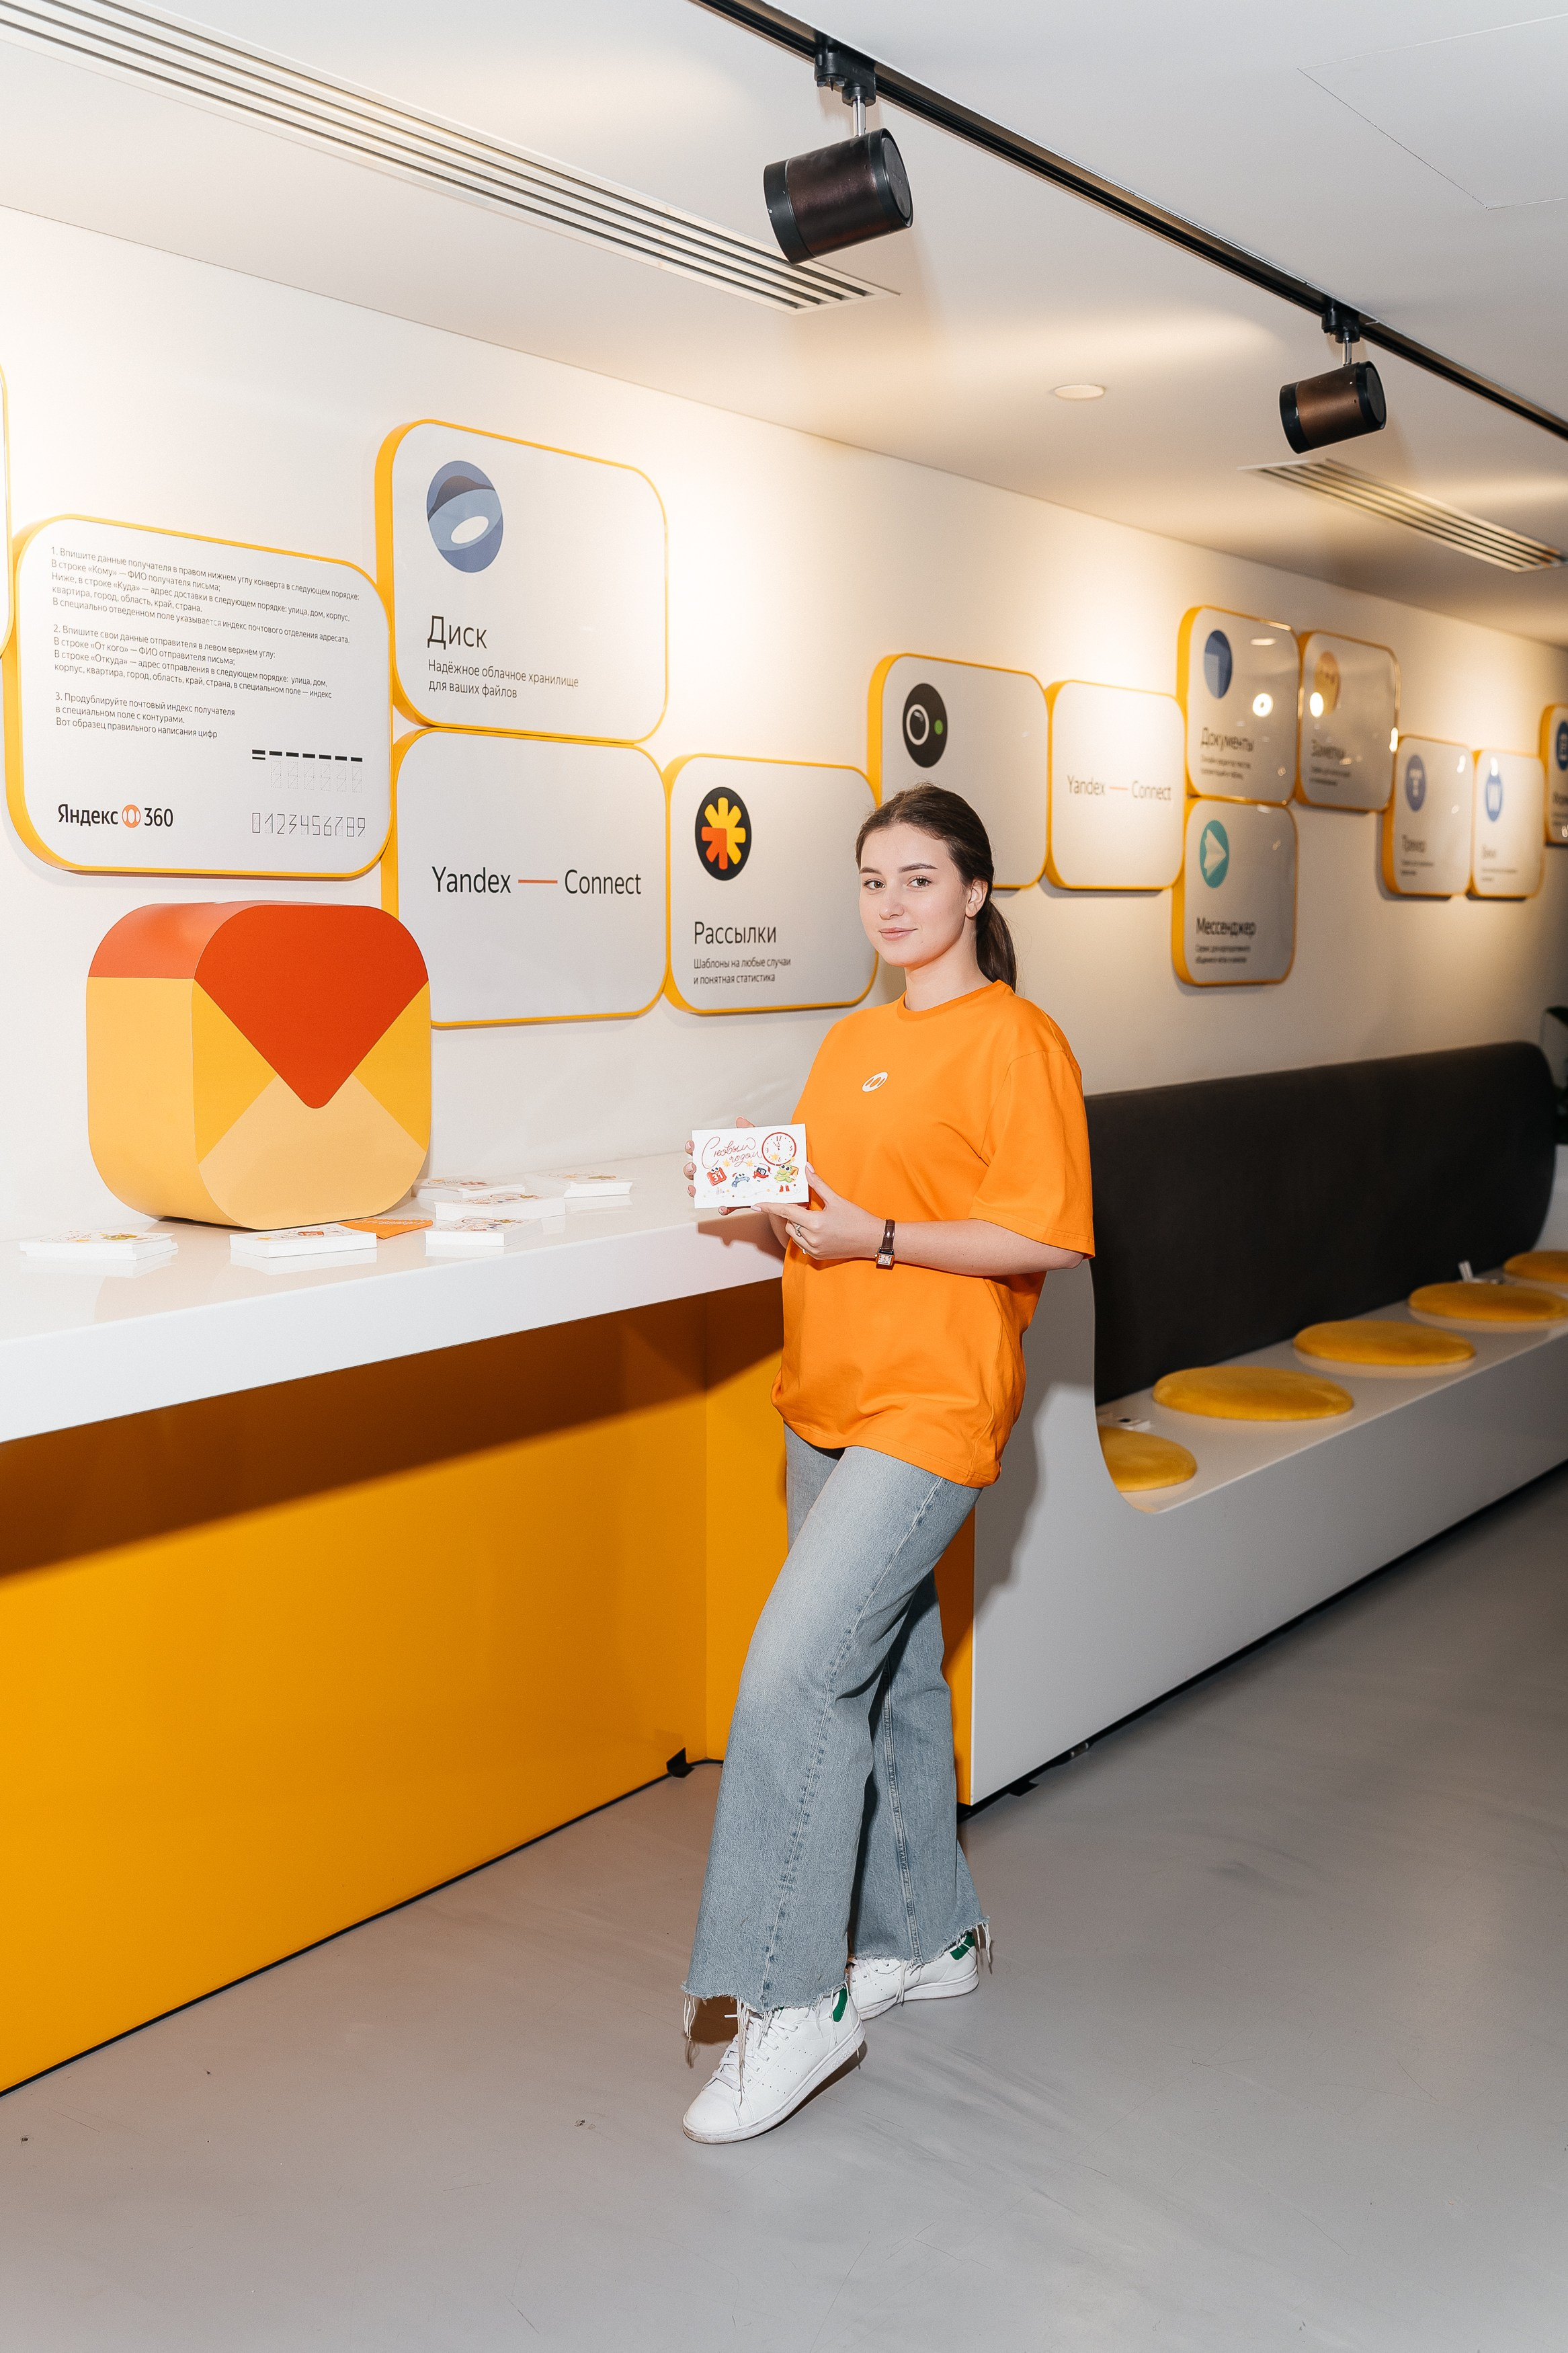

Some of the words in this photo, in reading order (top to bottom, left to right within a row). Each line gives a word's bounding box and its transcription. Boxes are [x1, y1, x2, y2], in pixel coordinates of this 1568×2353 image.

[59, 561, 86, 571] строке
[89, 565, 117, 575] «Кому»
[128, 571, 147, 580] ФИО
[149, 575, 191, 587] получателя
[192, 581, 220, 592] письма;
[60, 548, 95, 561] Впишите
[97, 555, 126, 565] данные
[128, 559, 171, 571] получателя
[179, 567, 206, 577] правом
[208, 572, 236, 582] нижнем
[238, 576, 253, 586] углу
[254, 578, 284, 591] конверта
[292, 585, 330, 596] следующем
[331, 591, 360, 600] порядке:
[52, 573, 77, 584] Ниже,
[85, 578, 112, 588] строке
[114, 581, 140, 592] «Куда»
[151, 588, 172, 596] адрес
[173, 590, 208, 601] доставки
[214, 597, 256, 608] следующем
[257, 602, 287, 612] порядке:
[288, 607, 308, 616] улица,
[327, 612, 350, 622] корпус,
[52, 586, 92, 598] квартира,
[93, 592, 119, 602] город,
[120, 595, 153, 606] область,
[155, 600, 173, 609] край,
[175, 604, 202, 612] страна.
[60, 600, 107, 612] специально
[109, 606, 155, 618] отведенном
[157, 612, 175, 621] поле
[175, 614, 221, 627] указывается
[222, 621, 247, 629] индекс
[248, 625, 283, 635] почтового
[284, 629, 318, 639] отделения
[319, 633, 349, 643] адресата.
[427, 615, 487, 650] Диск
[61, 640, 89, 649] строке
[91, 641, 105, 650] «От
[107, 644, 128, 653] кого»
[139, 647, 157, 656] ФИО
[159, 651, 206, 662] отправителя
[208, 655, 235, 666] письма;
[63, 625, 98, 637] Впишите
[100, 631, 118, 639] свои
[120, 634, 148, 643] данные
[150, 637, 197, 649] отправителя
[204, 644, 226, 652] левом
[228, 646, 257, 656] верхнем
[259, 650, 276, 659] углу:
[54, 664, 85, 674] корпус,
[87, 667, 125, 678] квартира,
[127, 671, 151, 680] город,
[153, 673, 183, 684] область,
[185, 676, 204, 686] край,
[206, 679, 233, 688] страна,
[239, 684, 284, 694] специальном
[62, 652, 89, 662] строке
[91, 654, 127, 665] «Откуда»
[138, 660, 160, 669] адрес
[162, 664, 209, 674] отправления
[216, 670, 257, 679] следующем
[259, 674, 288, 682] порядке:
[291, 678, 312, 686] улица,
[313, 680, 327, 688] дом,
[429, 659, 479, 676] Надёжное
[482, 666, 526, 682] облачное
[528, 673, 579, 688] хранилище
[429, 680, 446, 692] для
[450, 682, 479, 694] ваших
[482, 684, 517, 699] файлов
[63, 707, 115, 719] специальном
[118, 711, 134, 719] поле
[142, 714, 185, 724] контурами.
[65, 693, 127, 707] Продублируйте
[129, 700, 165, 709] почтовый
[167, 704, 193, 713] индекс
[195, 706, 235, 716] получателя
[56, 717, 71, 726] Вот
[73, 719, 106, 730] образец
[108, 723, 156, 733] правильного
[158, 727, 196, 737] написания
[198, 729, 218, 739] цифр
[1067, 775, 1105, 795] Yandex
[1132, 781, 1171, 801] Connect
[58, 803, 118, 826] Яндекс
[144, 807, 173, 827] 360
[431, 866, 511, 893] Yandex
[565, 869, 641, 895] Connect
[694, 921, 776, 944] Рассылки
[694, 959, 729, 969] Шаблоны
[731, 959, 739, 967] на
[741, 957, 765, 967] любые
[767, 959, 791, 968] случаи
[700, 975, 735, 984] понятная
[736, 974, 775, 983] статистика
[712, 1172, 723, 1182] 31
